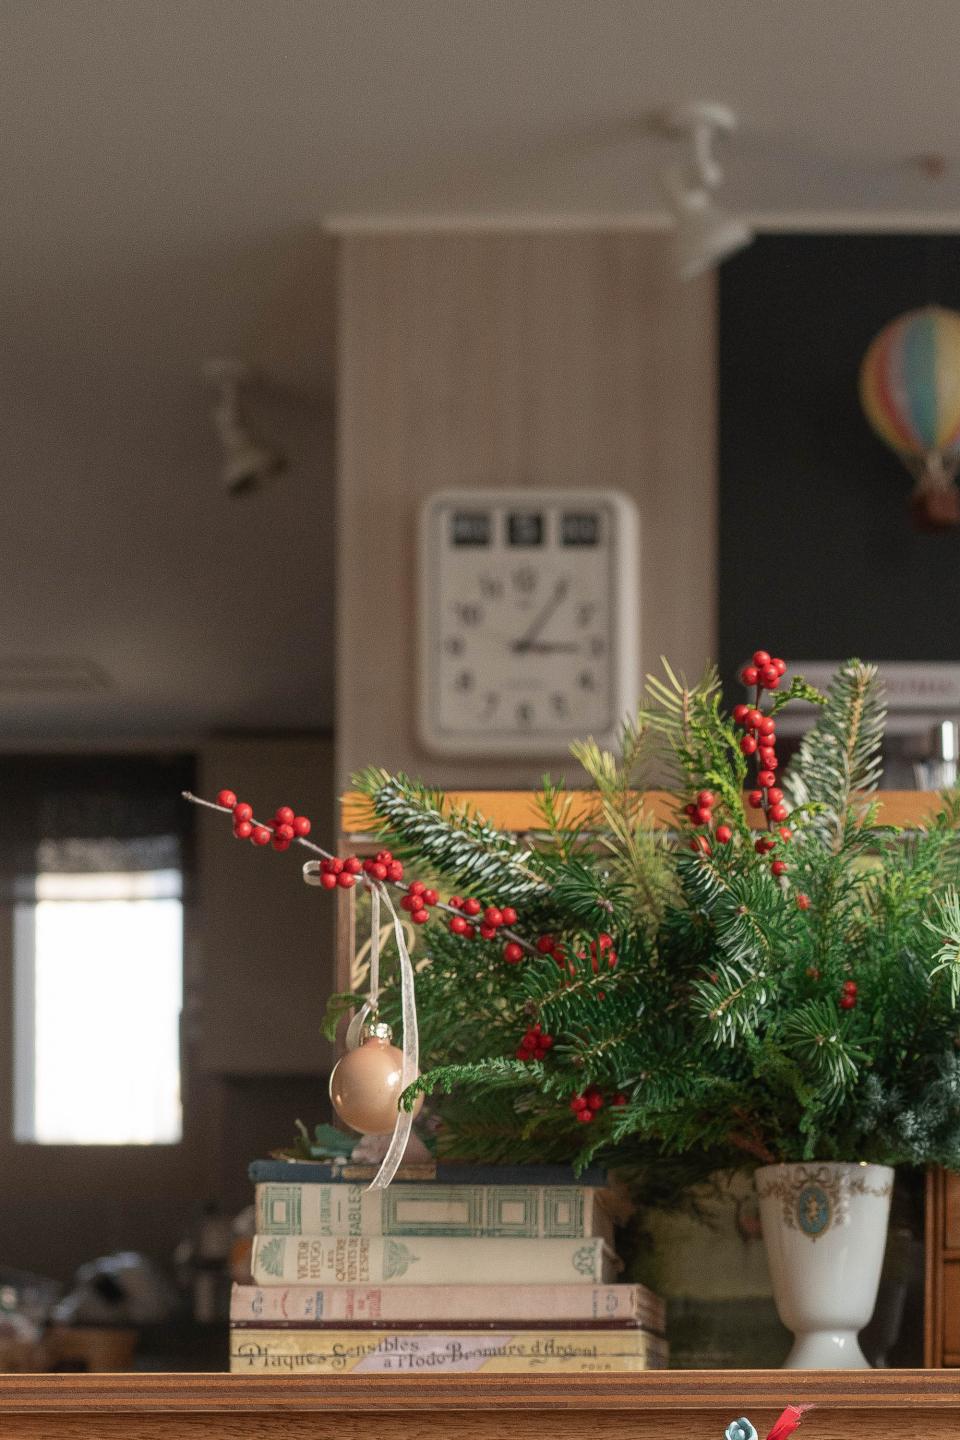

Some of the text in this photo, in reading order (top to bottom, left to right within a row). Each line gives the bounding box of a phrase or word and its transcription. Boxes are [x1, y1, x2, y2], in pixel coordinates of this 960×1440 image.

[347, 1184, 362, 1236] FABLES
[297, 1240, 309, 1280] VICTOR
[309, 1240, 321, 1279] HUGO
[335, 1239, 346, 1281] QUATRE
[238, 1342, 326, 1370] Plaques
